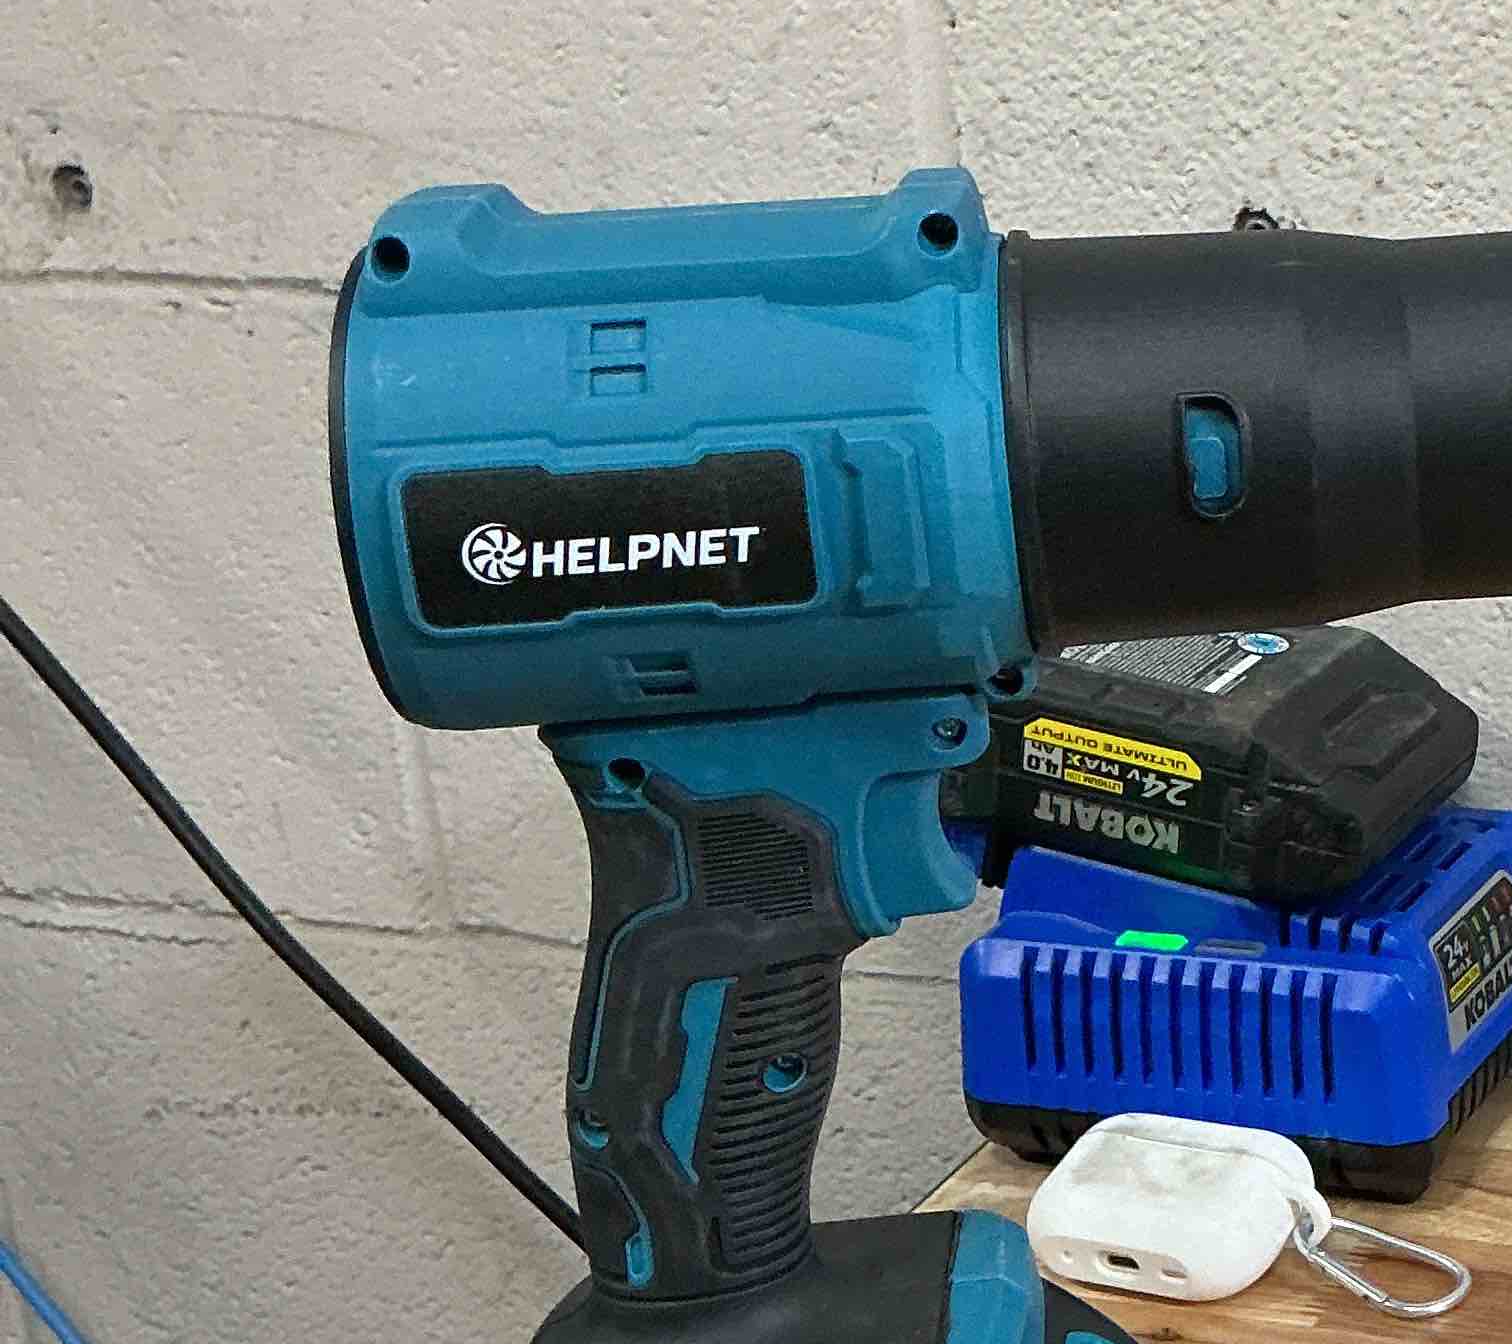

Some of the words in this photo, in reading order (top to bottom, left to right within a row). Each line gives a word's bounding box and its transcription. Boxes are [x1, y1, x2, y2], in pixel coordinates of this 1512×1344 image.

[532, 525, 759, 577] HELPNET
[1031, 726, 1098, 748] OUTPUT
[1026, 754, 1059, 776] 4.0
[1065, 751, 1120, 776] MAX
[1104, 743, 1187, 771] ULTIMATE
[1033, 790, 1180, 855] KOBALT
